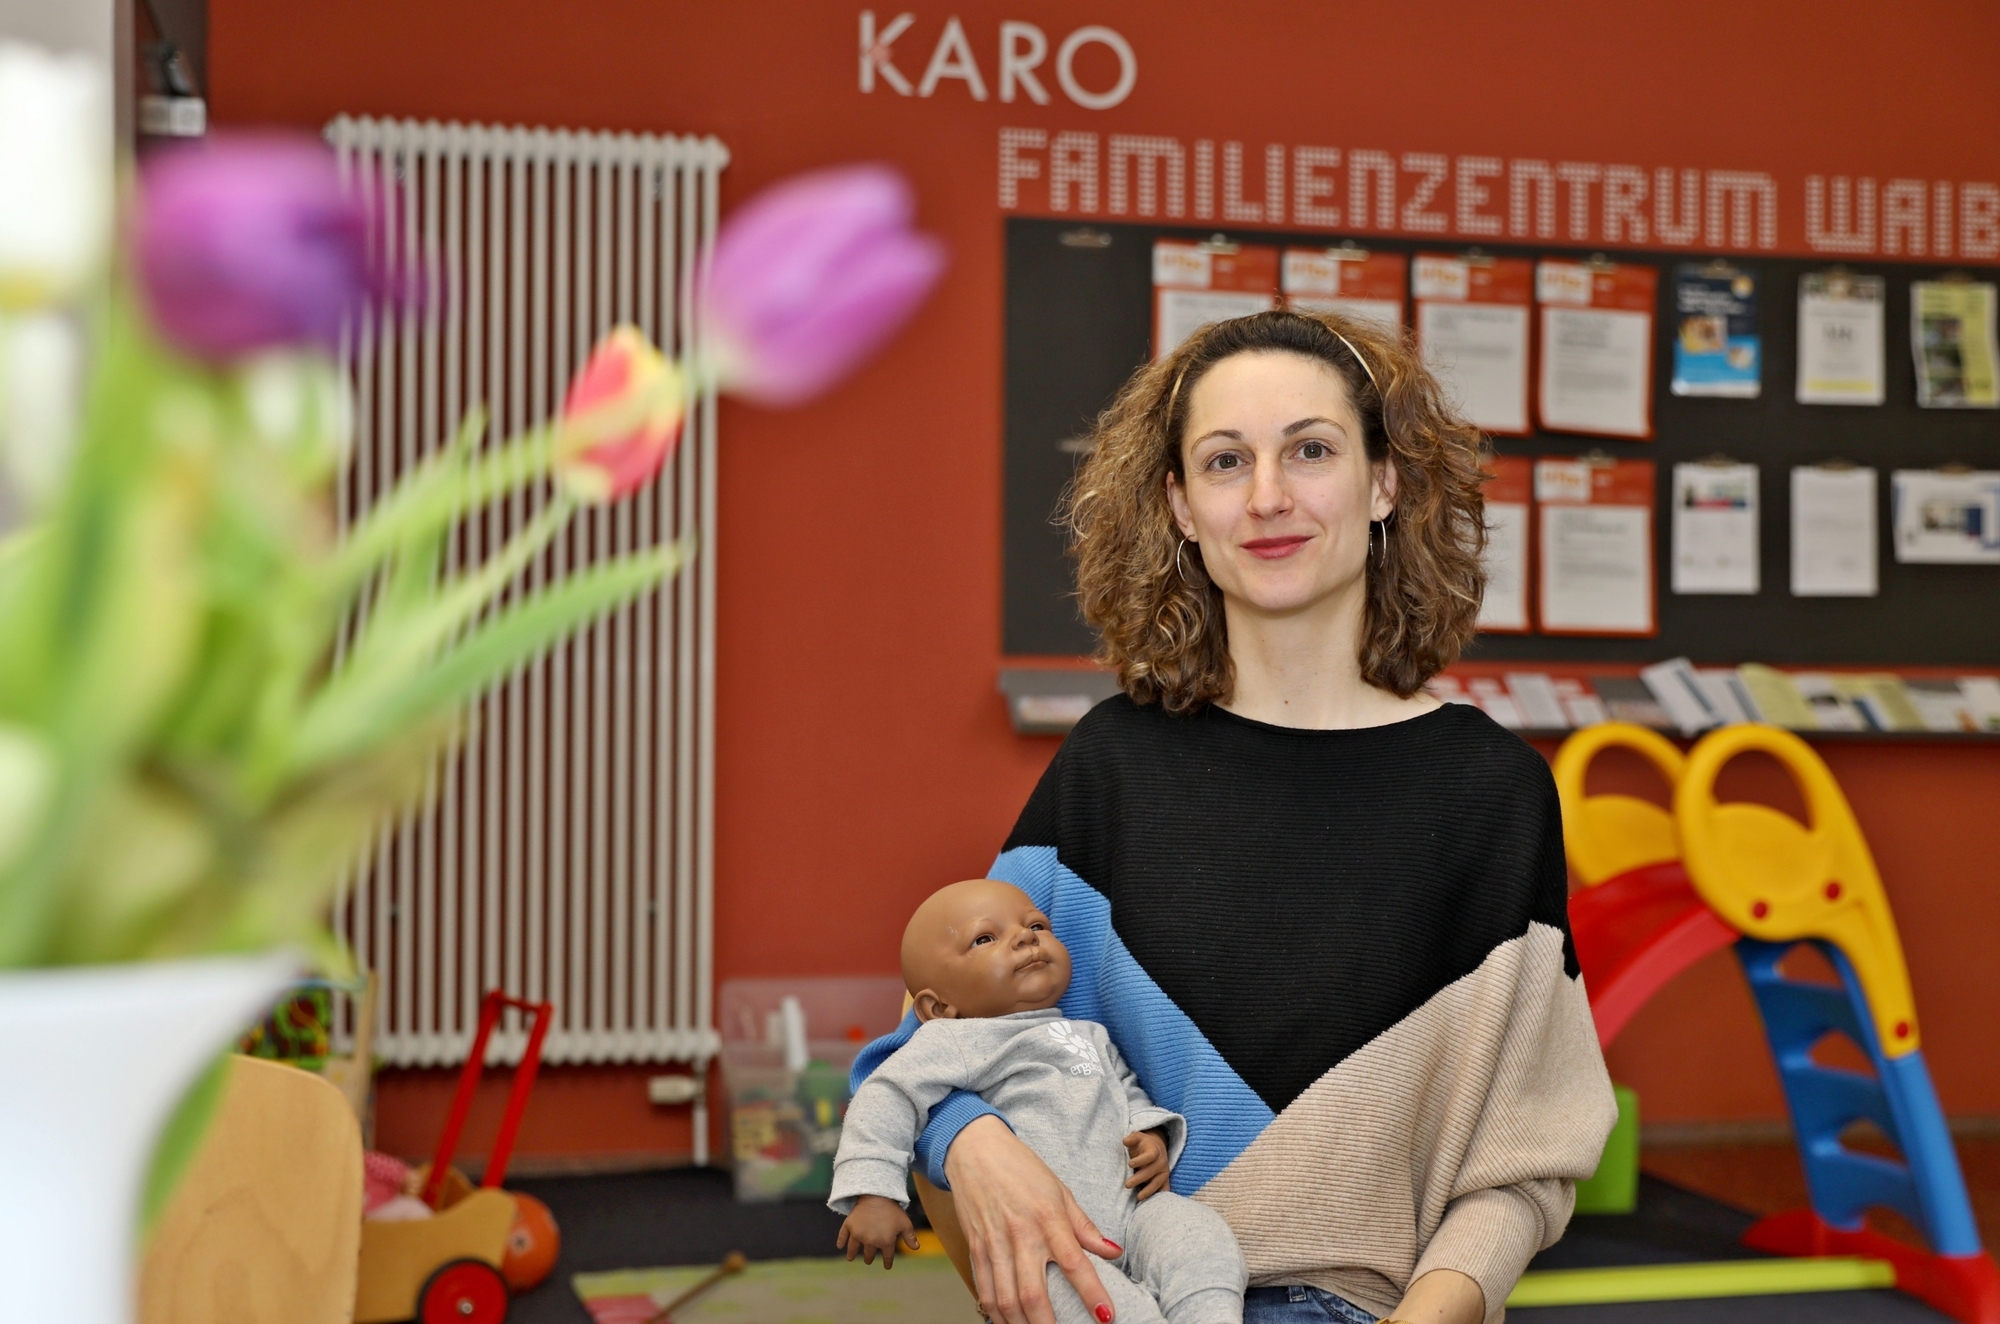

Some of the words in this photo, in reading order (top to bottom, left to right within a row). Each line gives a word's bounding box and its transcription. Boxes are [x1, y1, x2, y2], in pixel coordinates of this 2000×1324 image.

[858, 9, 1137, 110] KARO
[998, 127, 1778, 248] FAMILIENZENTRUM
[1804, 174, 2000, 259] WAIB
